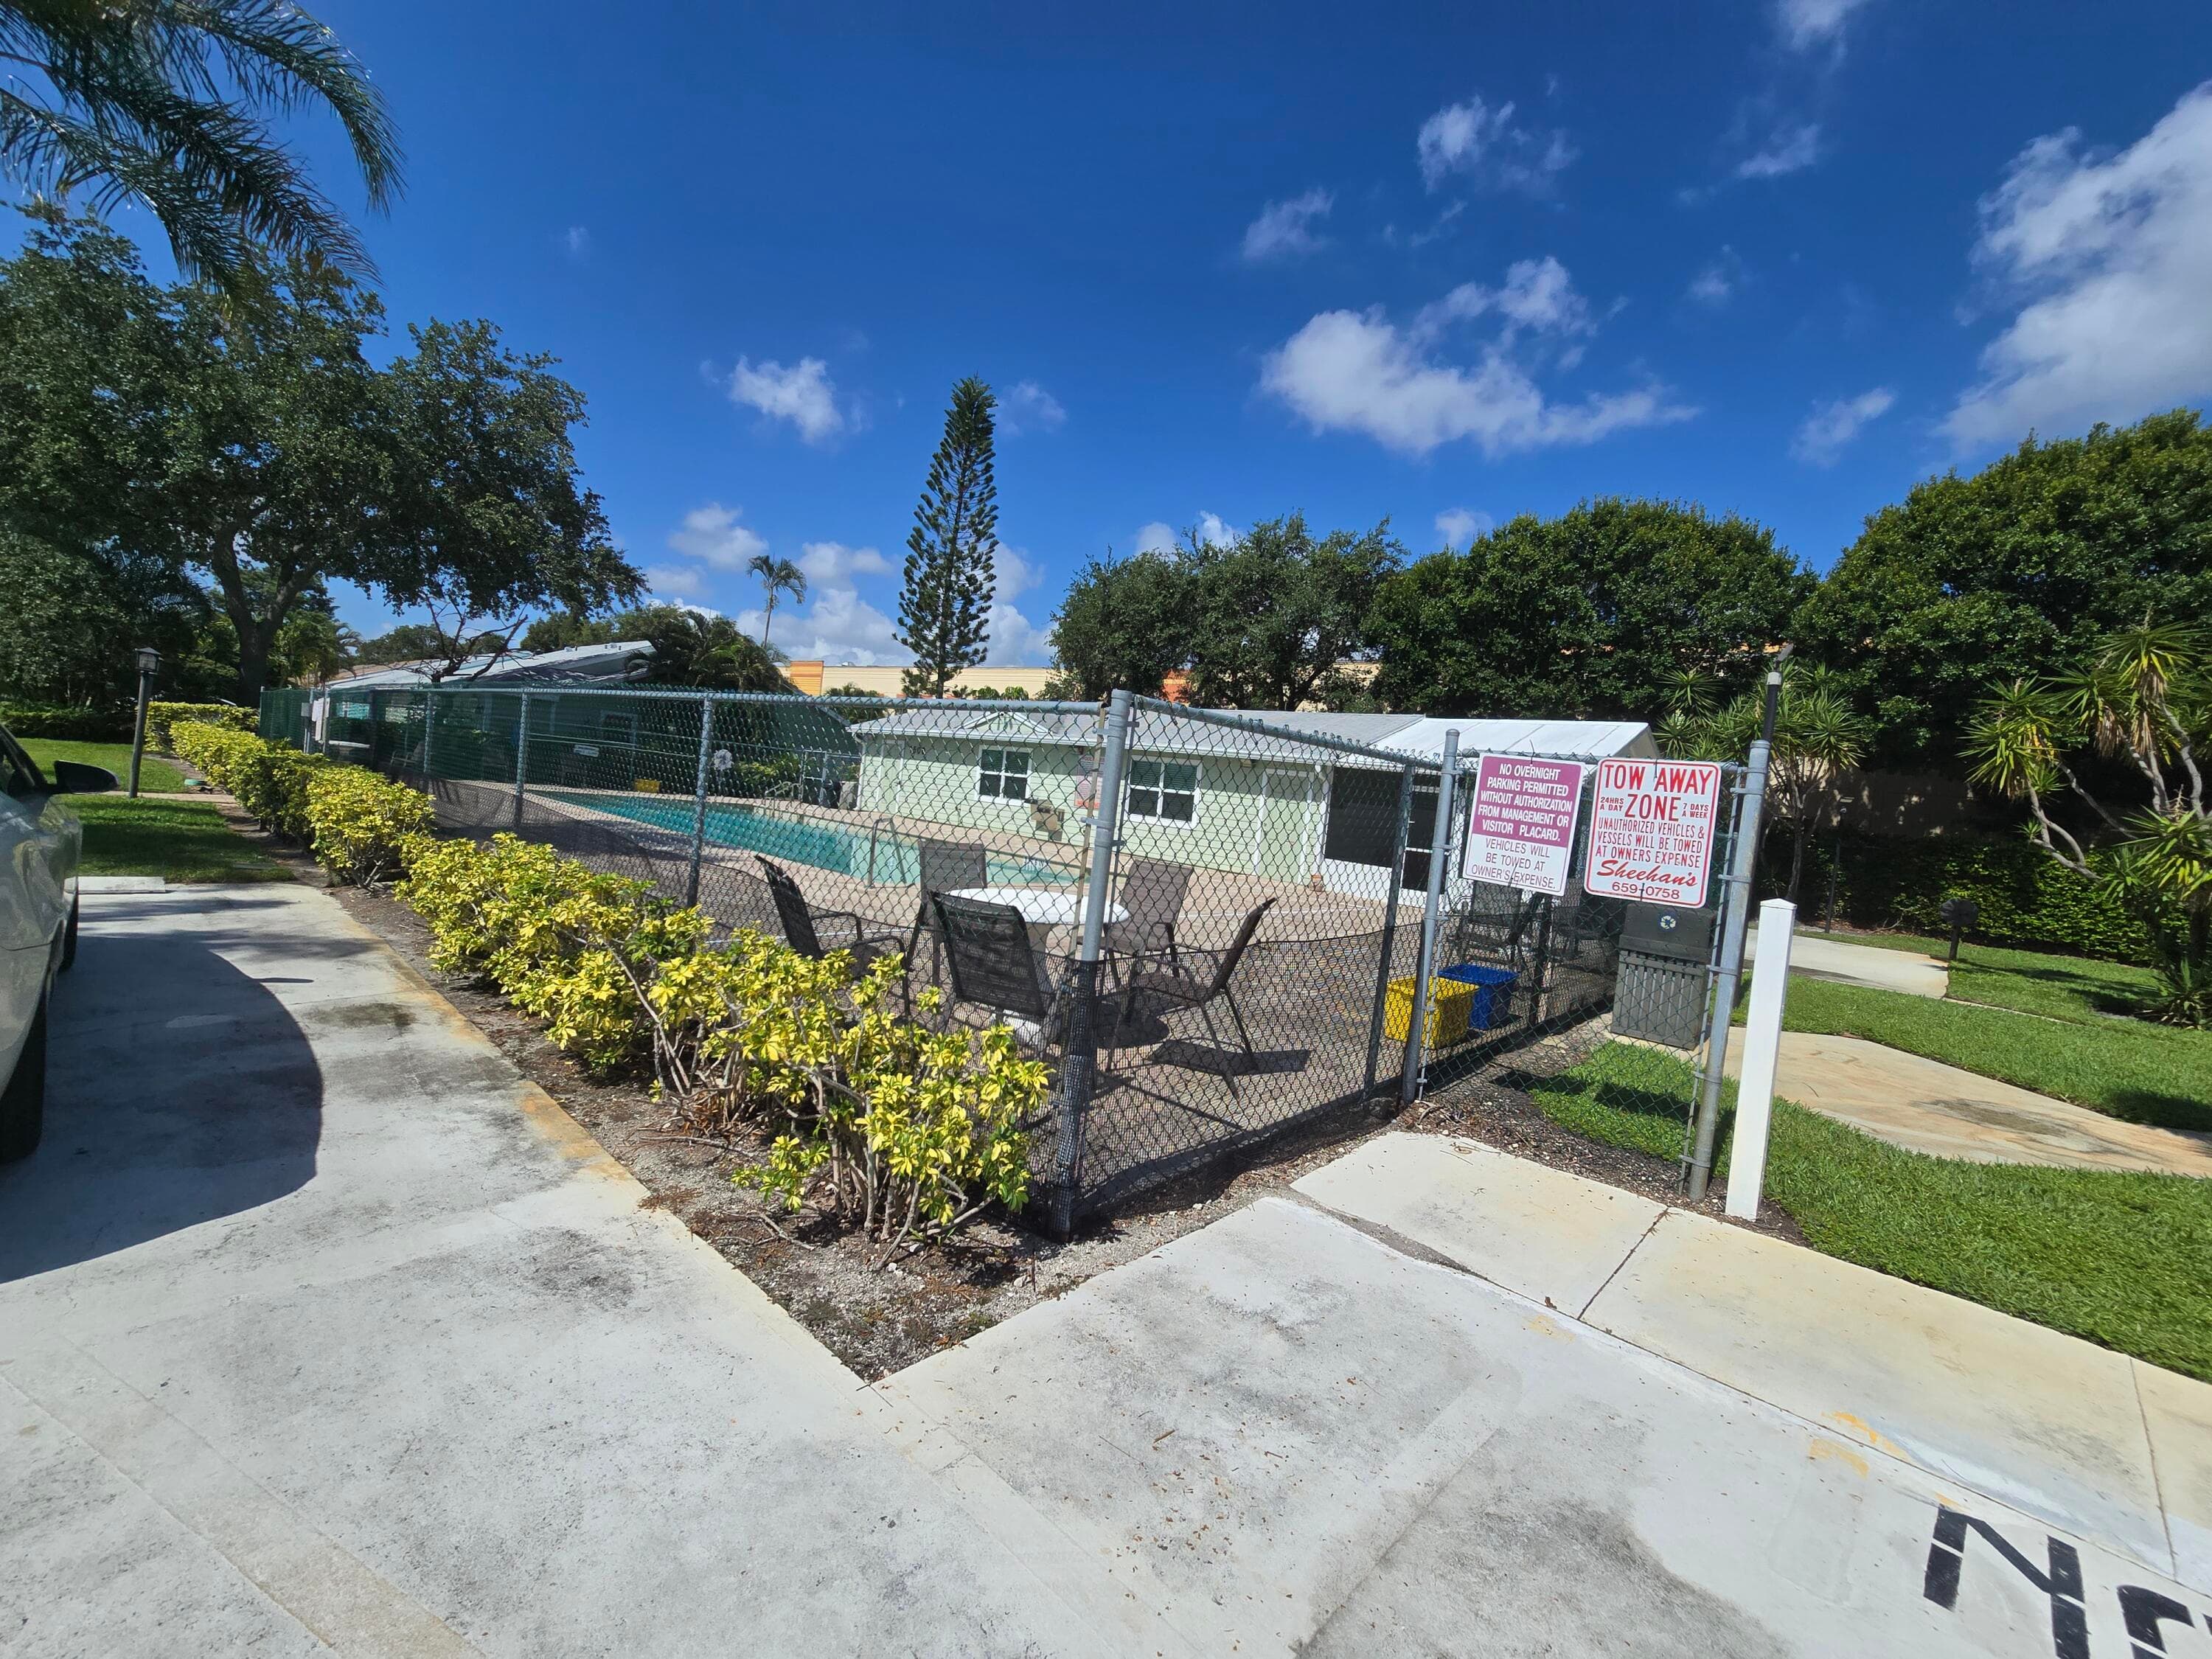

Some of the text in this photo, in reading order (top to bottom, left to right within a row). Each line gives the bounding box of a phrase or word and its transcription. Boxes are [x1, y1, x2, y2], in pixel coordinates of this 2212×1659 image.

[1499, 763, 1561, 781] NO OVERNIGHT
[1604, 764, 1714, 795] TOW AWAY
[1487, 776, 1569, 796] PARKING PERMITTED
[1481, 790, 1573, 813] WITHOUT AUTHORIZATION
[1600, 796, 1624, 804] 24HRS
[1624, 793, 1681, 822] ZONE
[1690, 804, 1709, 812] DAYS
[1478, 804, 1569, 827] FROM MANAGEMENT OR
[1482, 819, 1560, 841] VISITOR PLACARD.
[1599, 818, 1705, 839] UNAUTHORIZED VEHICLES &
[1486, 838, 1550, 858] VEHICLES WILL
[1598, 831, 1703, 853] VESSELS WILL BE TOWED
[1486, 852, 1545, 872] BE TOWED AT
[1596, 844, 1701, 868] AT OWNERS EXPENSE
[1472, 864, 1556, 889] OWNER'S EXPENSE.
[1596, 859, 1698, 886] Sheehan's
[1612, 882, 1680, 900] 659-0758
